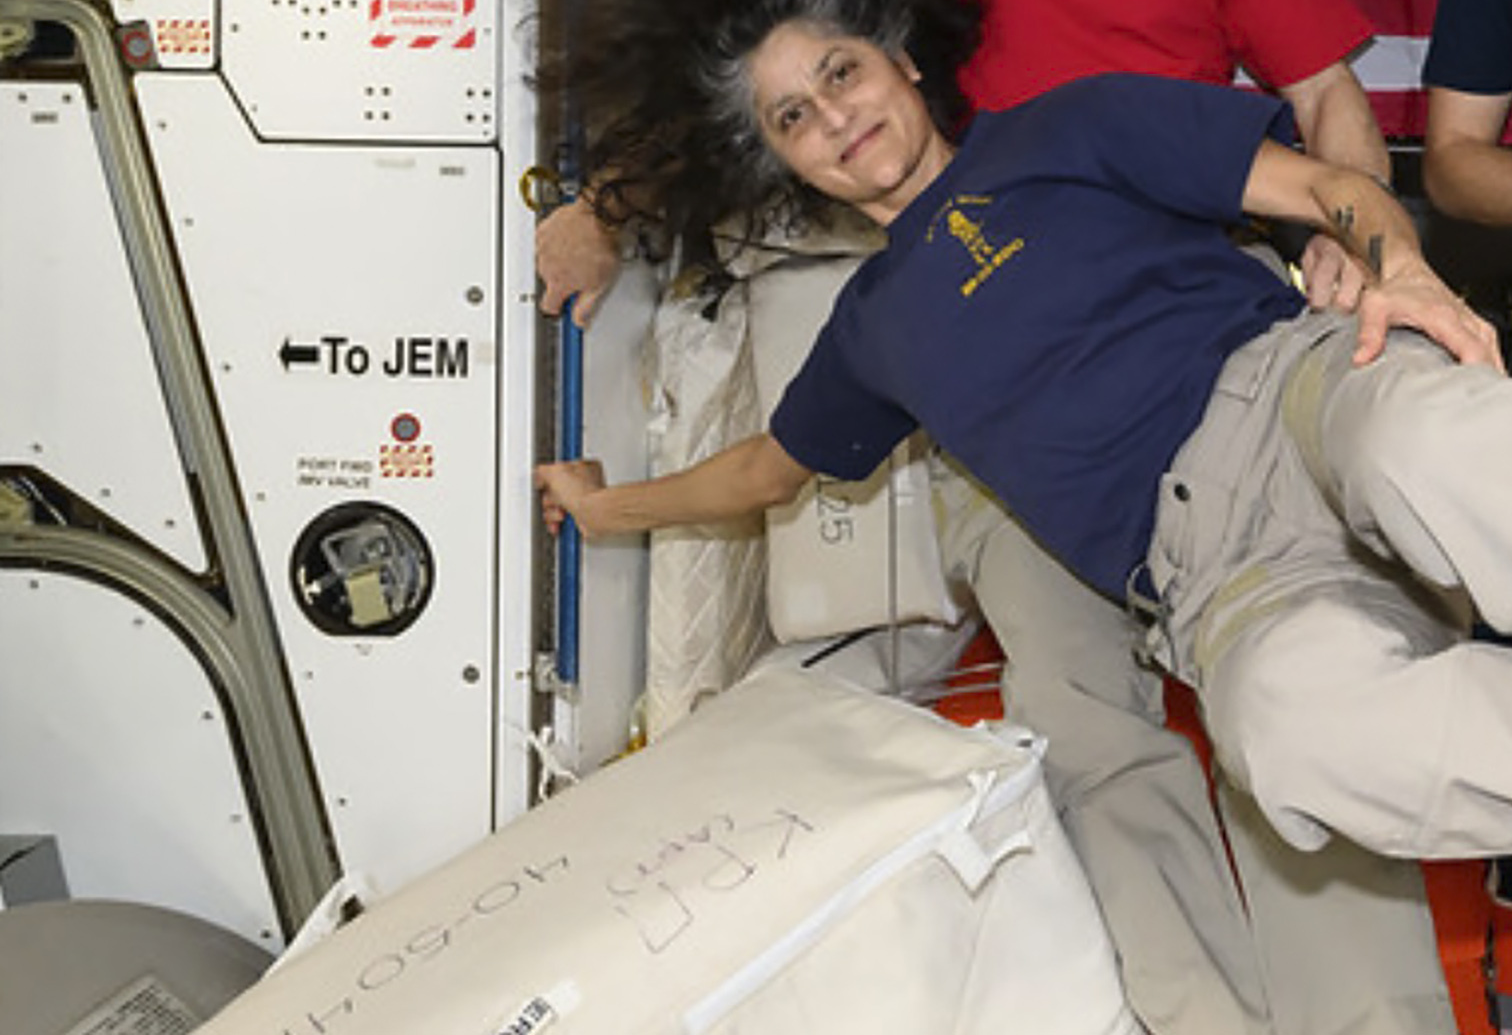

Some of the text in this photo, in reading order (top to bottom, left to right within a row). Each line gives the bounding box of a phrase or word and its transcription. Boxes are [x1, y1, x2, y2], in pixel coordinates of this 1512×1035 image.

[388, 0, 457, 12] BREATHING
[321, 336, 469, 379] To JEM
